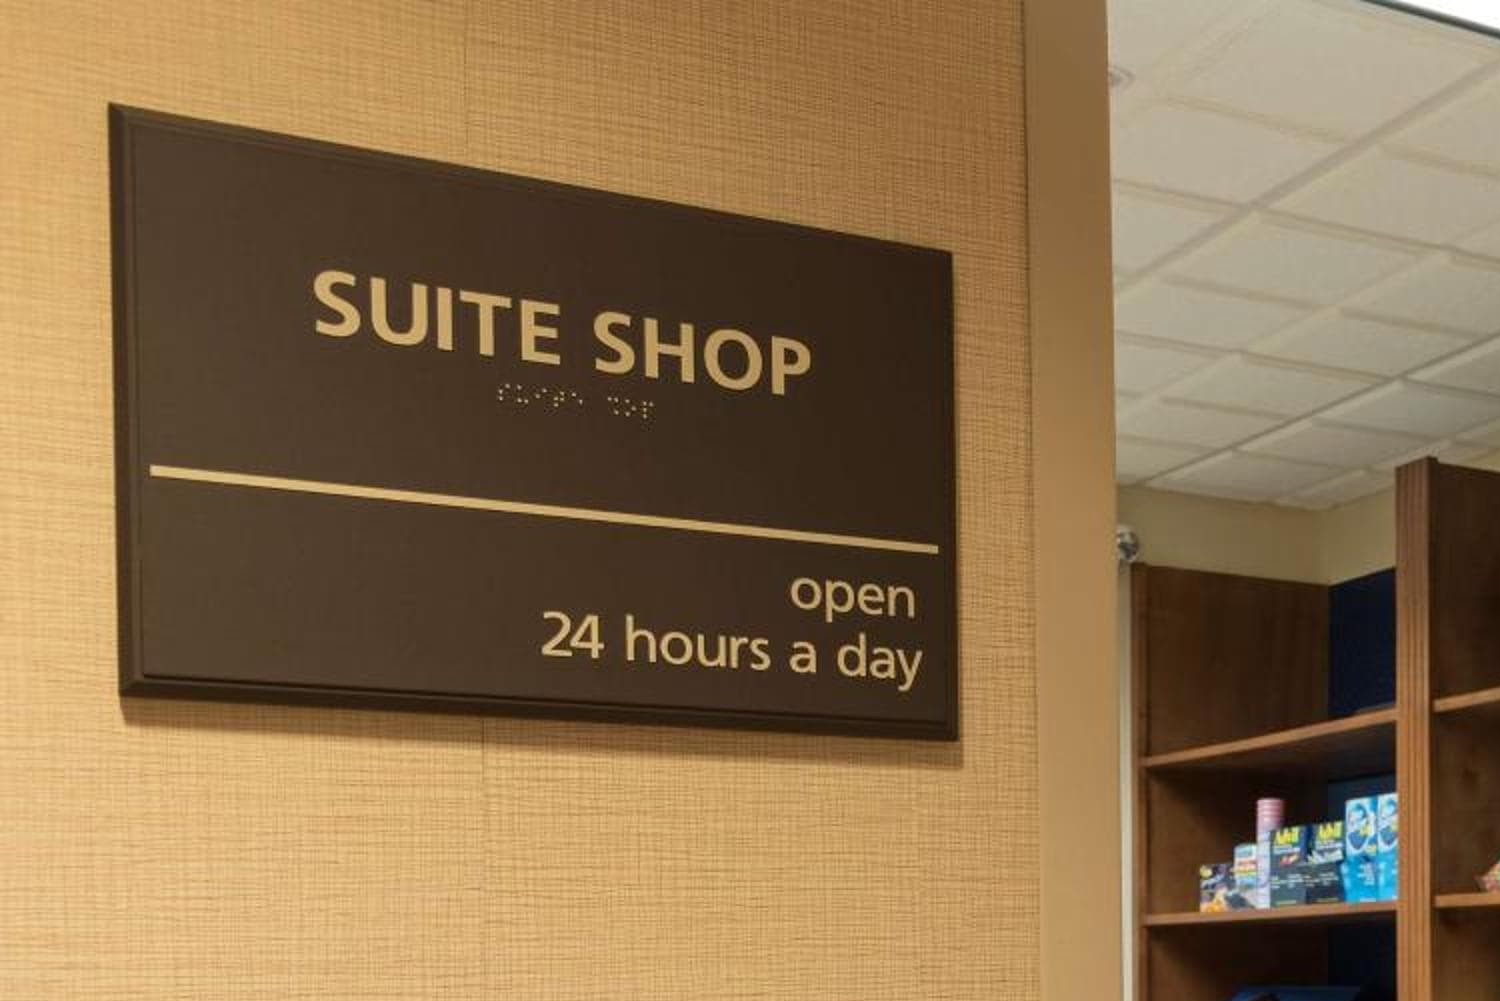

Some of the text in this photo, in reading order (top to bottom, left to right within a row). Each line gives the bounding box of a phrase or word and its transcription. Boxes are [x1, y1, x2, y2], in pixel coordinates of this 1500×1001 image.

[314, 271, 811, 395] SUITE SHOP
[791, 578, 915, 622] open
[541, 612, 922, 690] 24 hours a day
